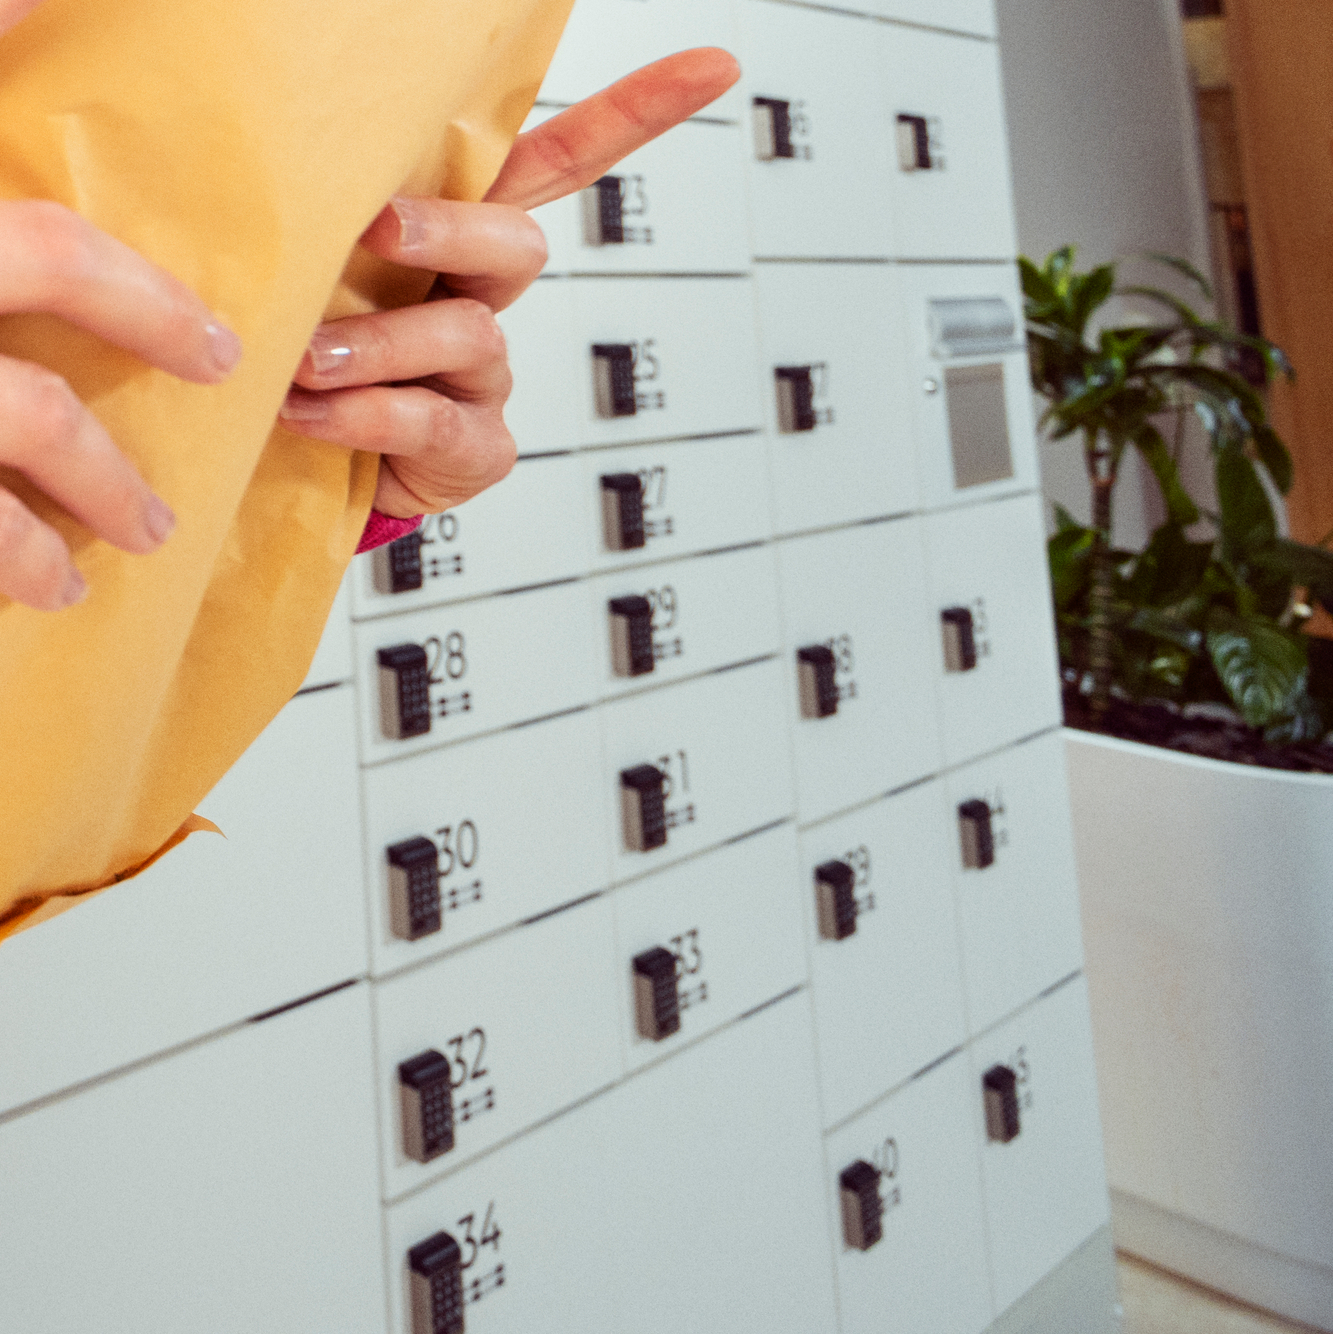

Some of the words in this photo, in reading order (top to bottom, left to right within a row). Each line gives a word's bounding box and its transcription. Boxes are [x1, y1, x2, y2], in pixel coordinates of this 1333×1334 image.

[424, 632, 465, 682] 28
[436, 819, 477, 876] 30
[448, 1028, 487, 1089] 32
[458, 1201, 501, 1268] 34
